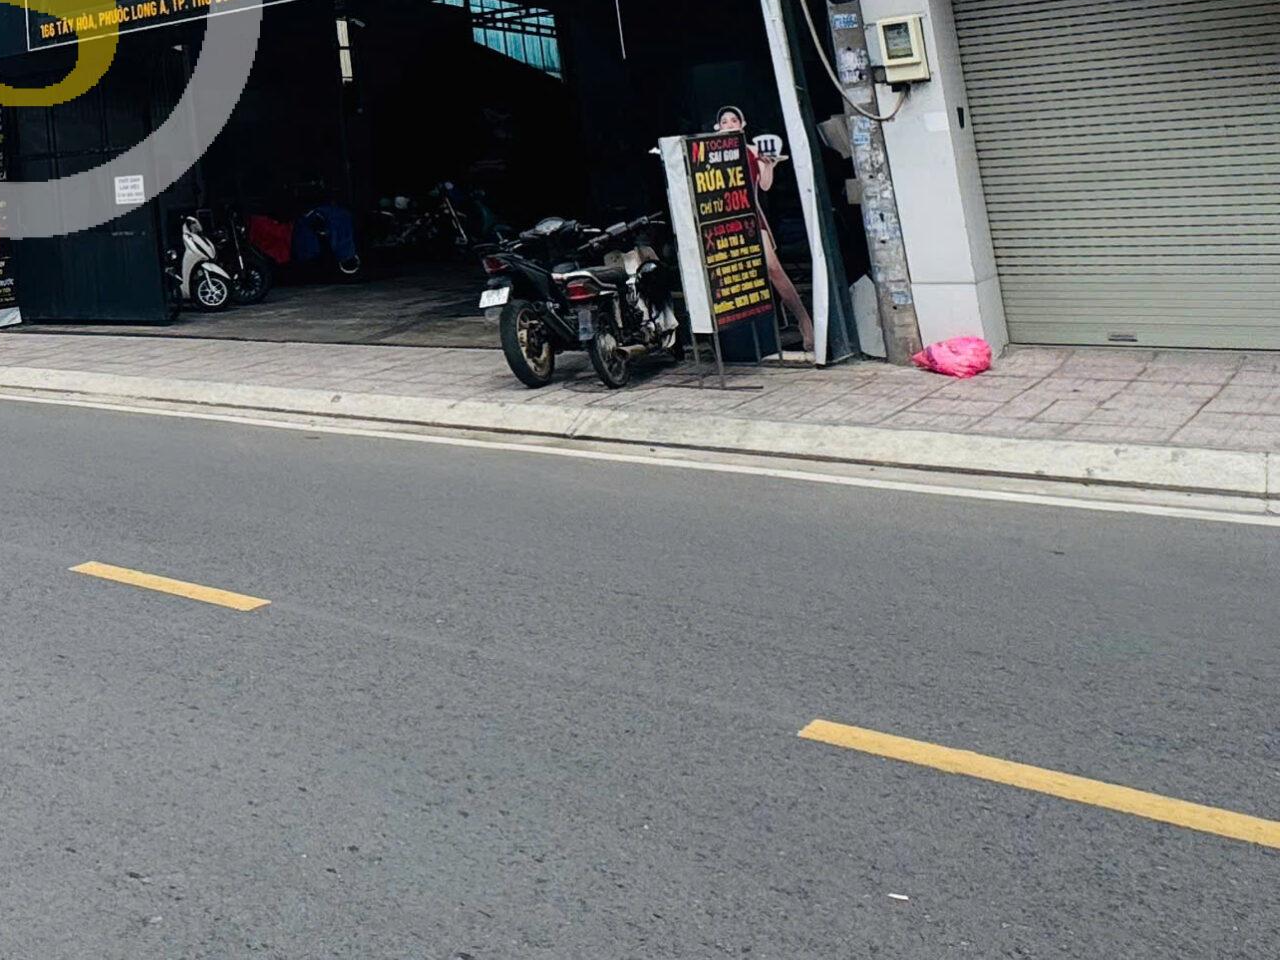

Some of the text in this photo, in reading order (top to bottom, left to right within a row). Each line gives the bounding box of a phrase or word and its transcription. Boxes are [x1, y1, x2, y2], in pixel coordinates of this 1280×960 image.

[40, 23, 55, 38] 166
[56, 17, 73, 35] TÂY
[131, 1, 157, 20] LONG
[695, 163, 746, 193] RỬA XE
[724, 189, 751, 212] 30K
